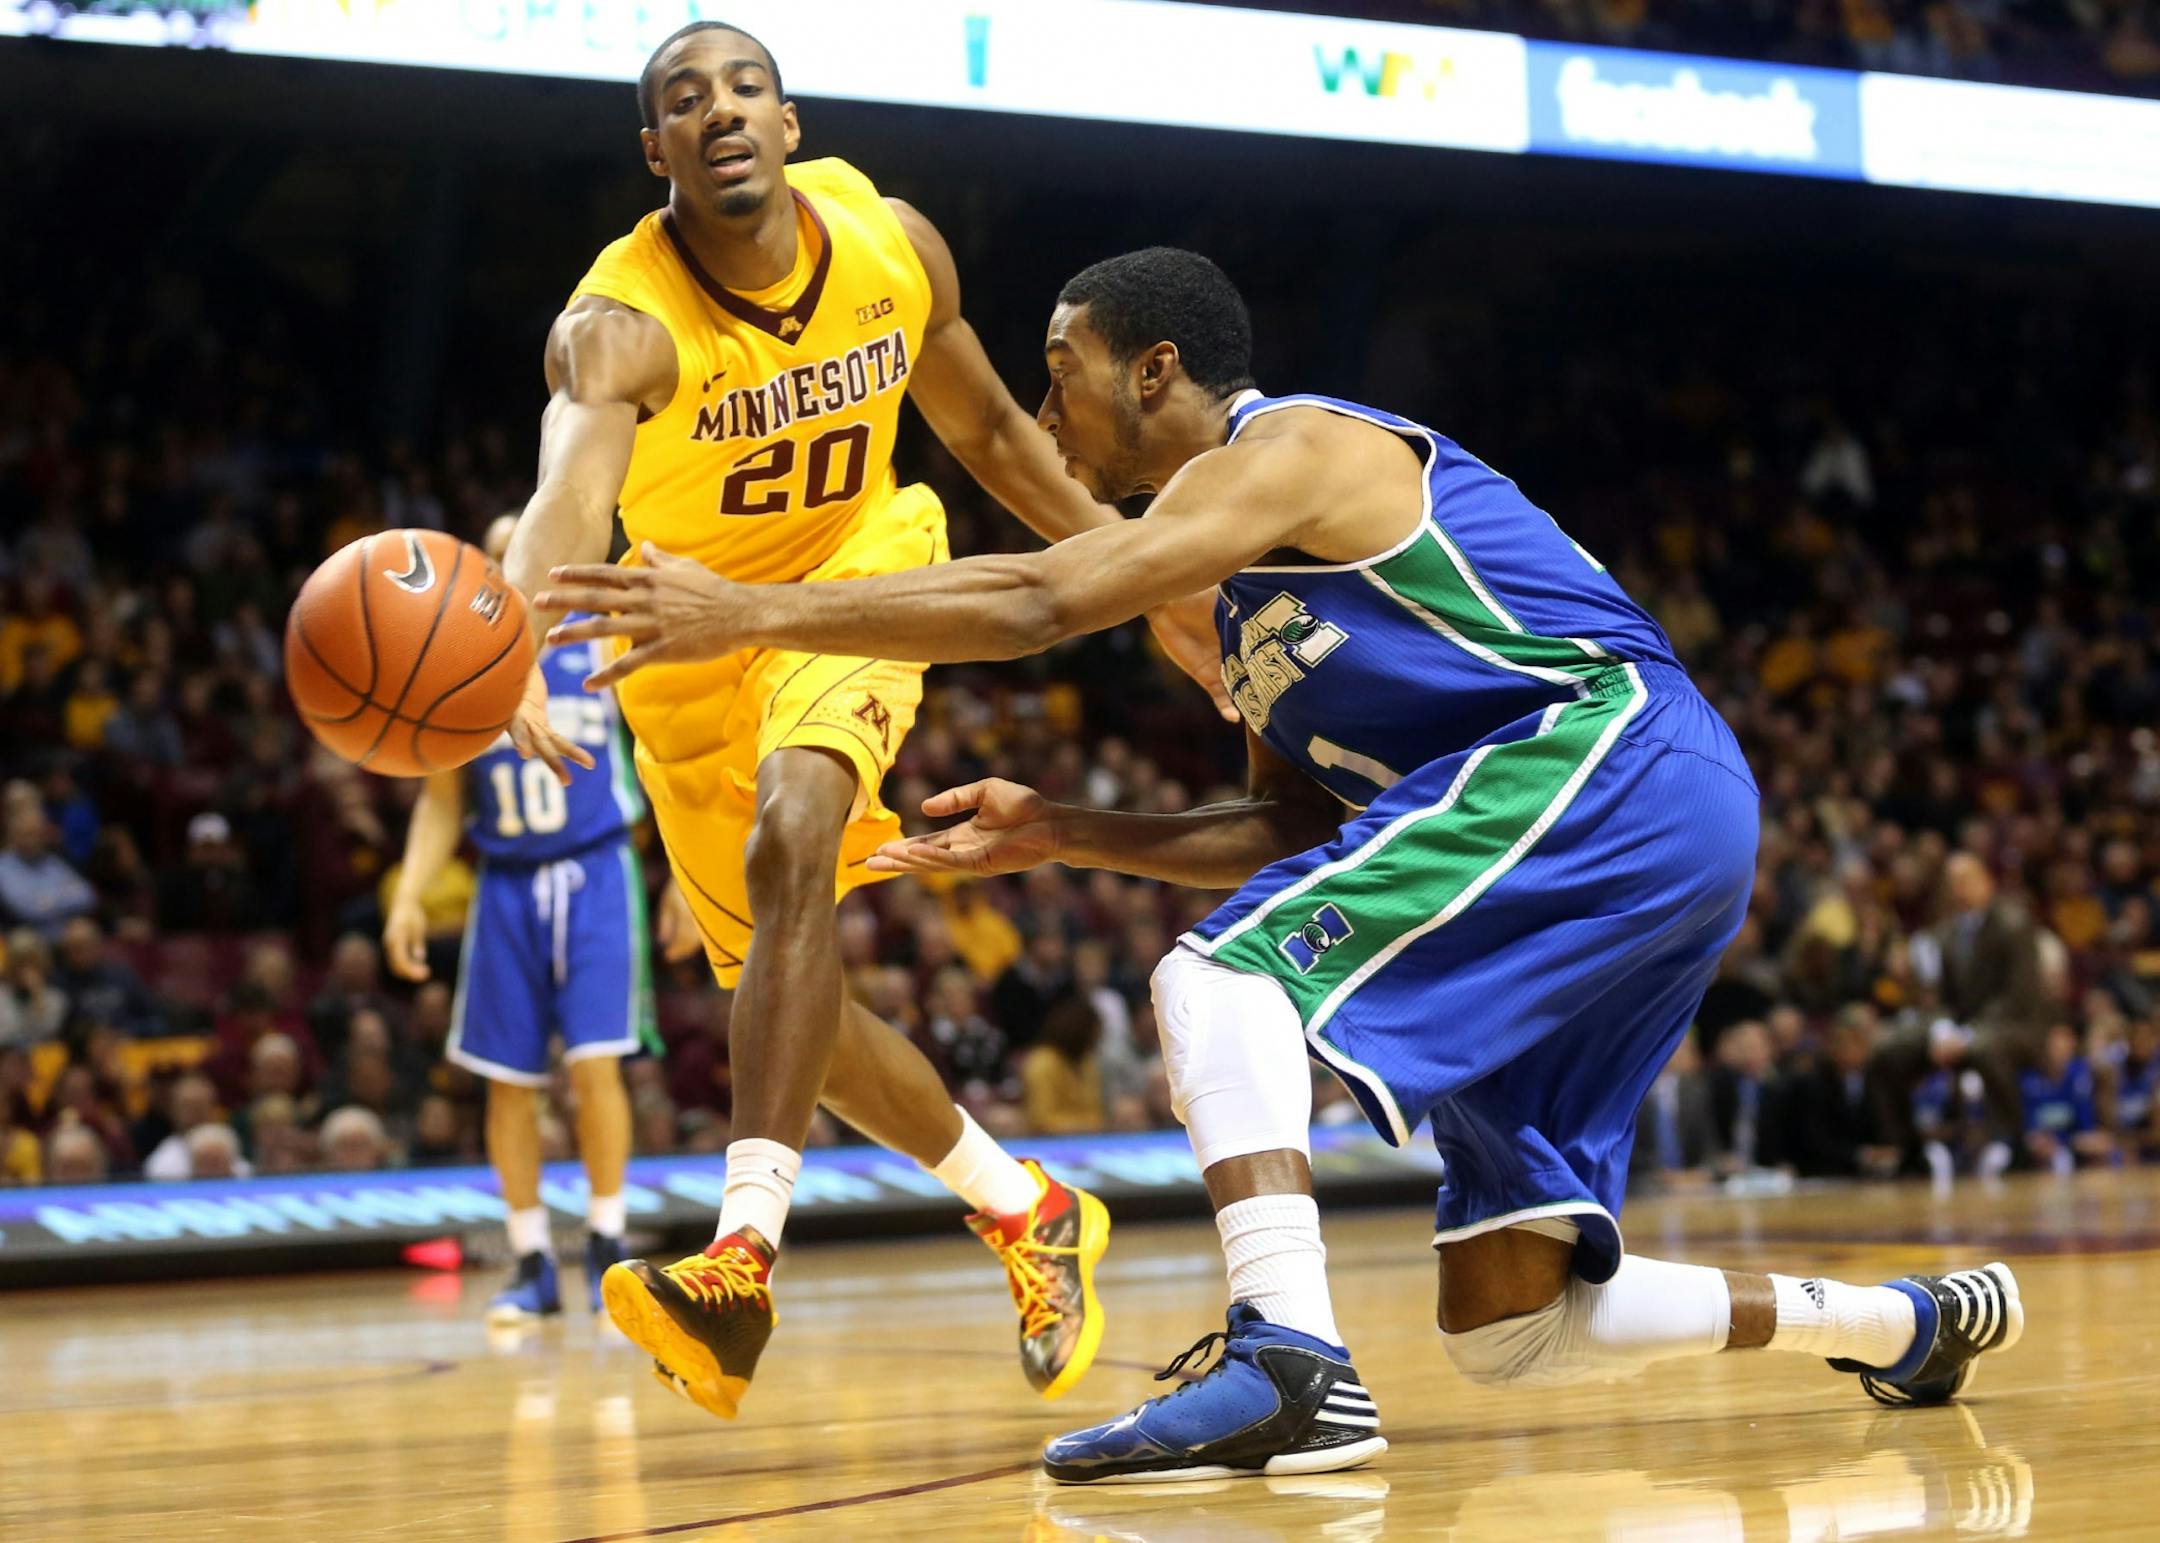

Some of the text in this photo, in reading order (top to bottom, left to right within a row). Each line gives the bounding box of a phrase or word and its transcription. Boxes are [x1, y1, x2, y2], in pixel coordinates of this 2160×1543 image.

[689, 328, 909, 441] MINNESOTA
[720, 424, 871, 515] 20
[490, 758, 568, 837] 10
